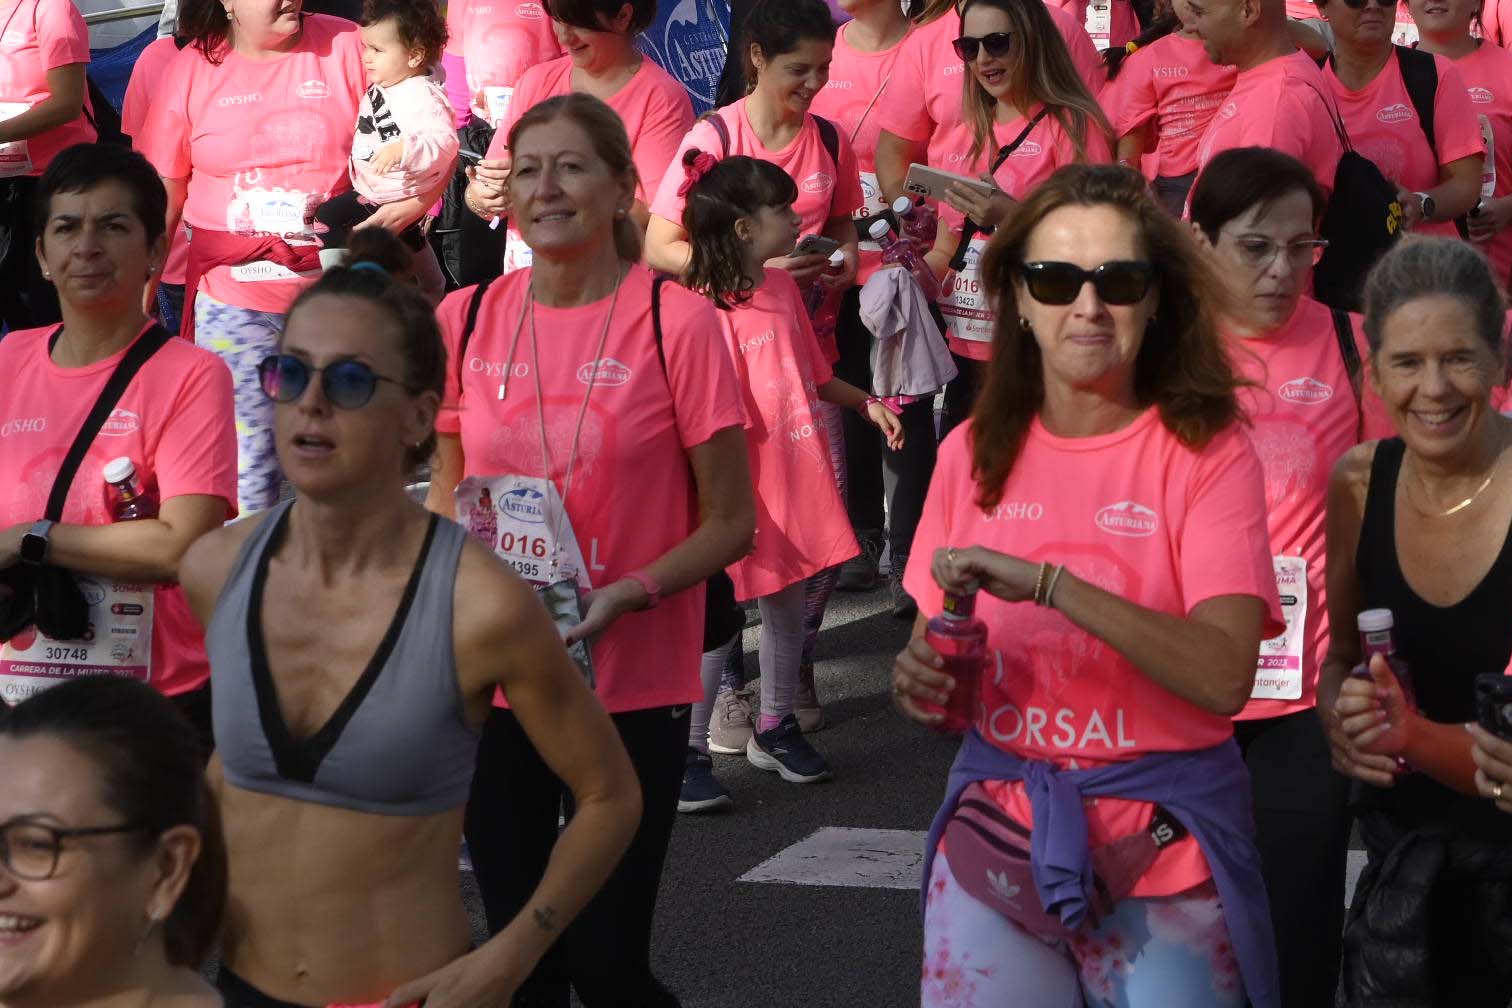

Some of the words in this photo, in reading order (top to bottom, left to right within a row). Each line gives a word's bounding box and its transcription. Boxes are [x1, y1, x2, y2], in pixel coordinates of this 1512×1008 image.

[219, 92, 263, 107] OYSHO
[240, 265, 272, 275] OYSHO
[955, 277, 979, 293] 016
[956, 295, 975, 307] 13423
[469, 356, 529, 378] OYSHO
[1100, 510, 1156, 530] ASTURIANA
[501, 532, 547, 558] 016
[46, 647, 88, 661] 30748
[9, 665, 47, 674] CARRERA
[48, 666, 61, 675] DE
[63, 668, 75, 676] LA
